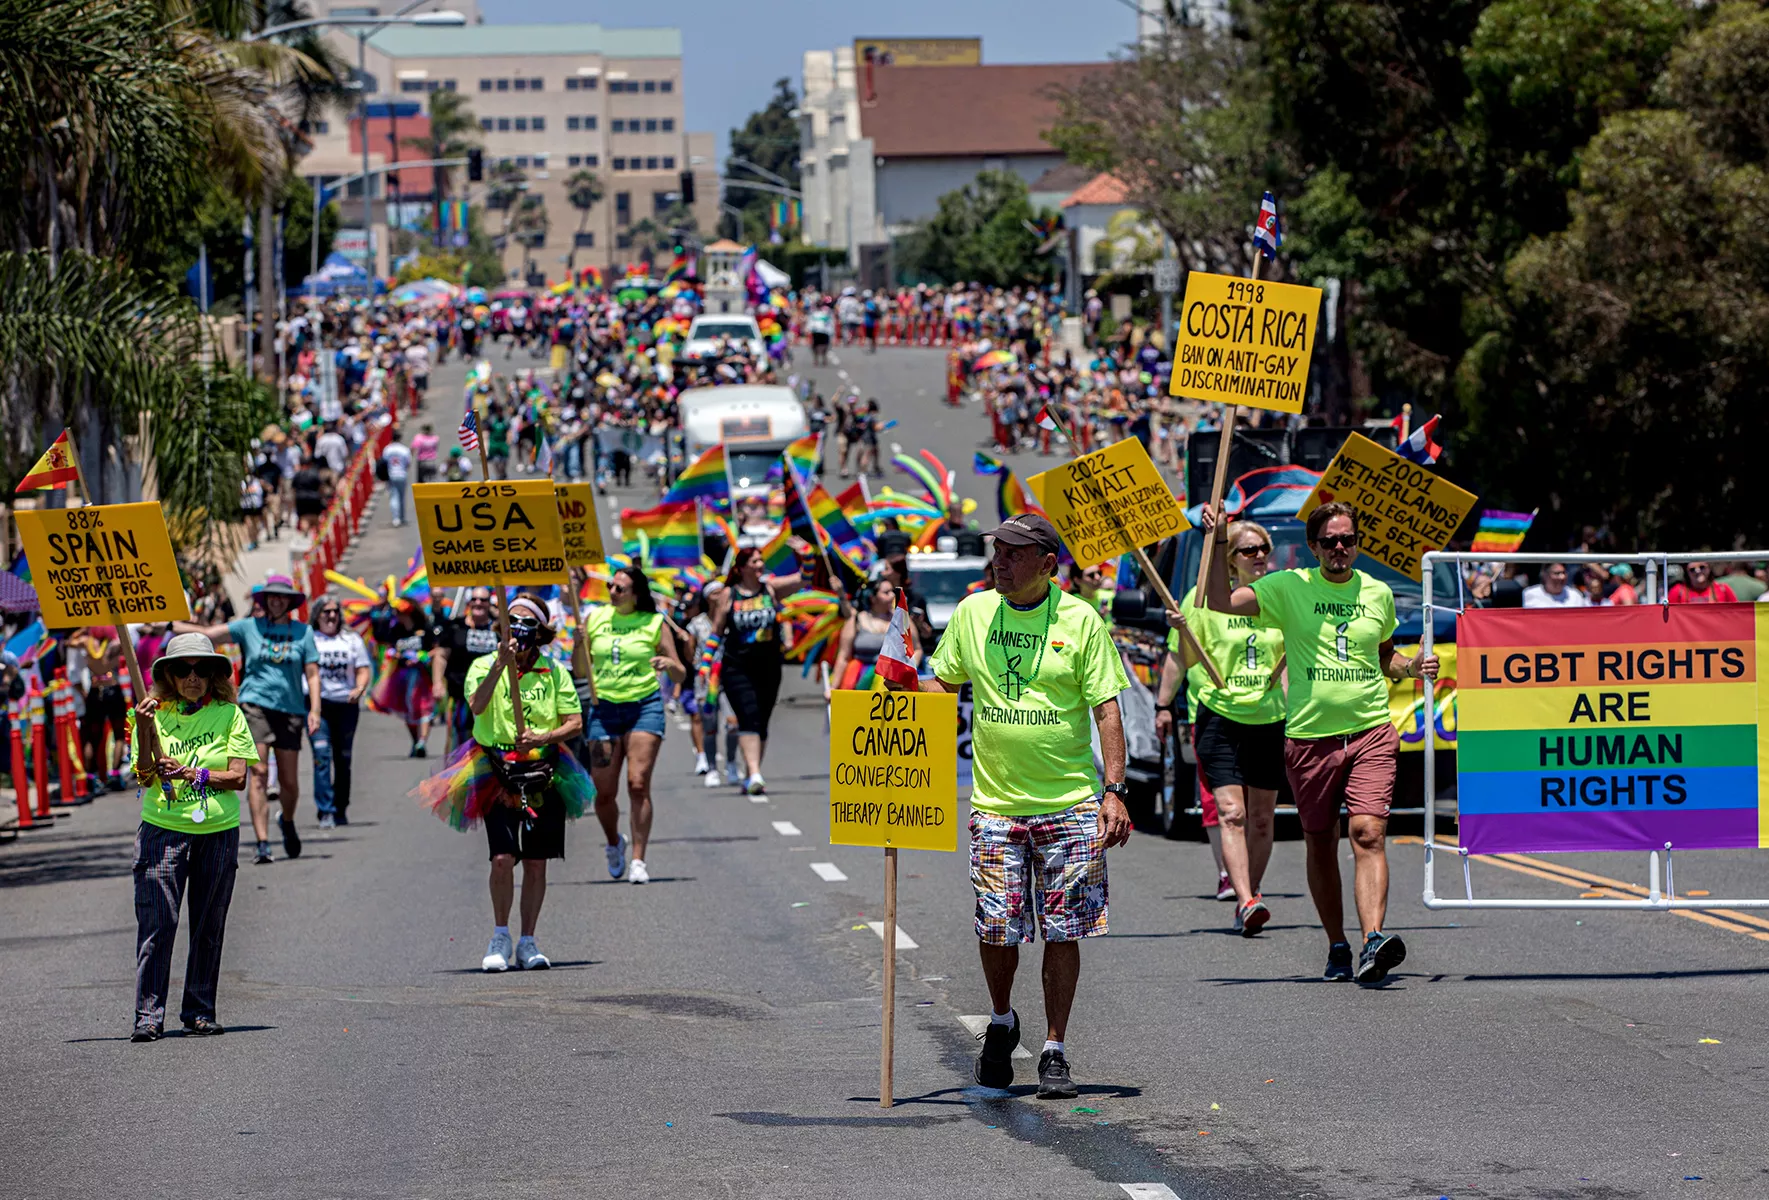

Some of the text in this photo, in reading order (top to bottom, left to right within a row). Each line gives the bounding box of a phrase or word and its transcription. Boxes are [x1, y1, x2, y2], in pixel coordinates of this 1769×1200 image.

[1227, 281, 1265, 304] 1998
[1187, 301, 1307, 351] COSTA RICA
[1181, 344, 1299, 377] BAN ON ANTI-GAY
[1181, 368, 1302, 402] DISCRIMINATION
[1067, 453, 1114, 483] 2022
[1381, 457, 1434, 496] 2001
[461, 485, 517, 499] 2015
[1062, 464, 1137, 509] KUWAIT
[1334, 454, 1460, 529] NETHERLANDS
[67, 510, 104, 530] 88%
[434, 502, 535, 533] USA
[1056, 482, 1165, 532] LAW CRIMINALIZING
[1064, 495, 1176, 546] TRANSGENDER PEOPLE
[1326, 475, 1449, 546] 1ST TO LEGALIZE
[47, 529, 139, 566] SPAIN
[433, 537, 537, 555] SAME SEX
[1081, 514, 1179, 561] OVERTURNED
[1357, 530, 1417, 574] RIAGE
[1386, 526, 1421, 552] SEX
[47, 562, 153, 585] MOST PUBLIC
[432, 557, 565, 575] MARRIAGE LEGALIZED
[55, 579, 152, 601] SUPPORT FOR
[64, 595, 167, 618] LGBT RIGHTS
[1313, 602, 1366, 617] AMNESTY
[989, 629, 1045, 650] AMNESTY
[1480, 647, 1746, 685] LGBT RIGHTS
[870, 692, 916, 722] 2021
[1568, 691, 1651, 723] ARE
[169, 731, 215, 757] AMNESTY
[852, 726, 928, 757] CANADA
[1539, 733, 1683, 766] HUMAN
[835, 762, 931, 789] CONVERSION
[1540, 774, 1687, 807] RIGHTS
[832, 801, 945, 828] THERAPY BANNED
